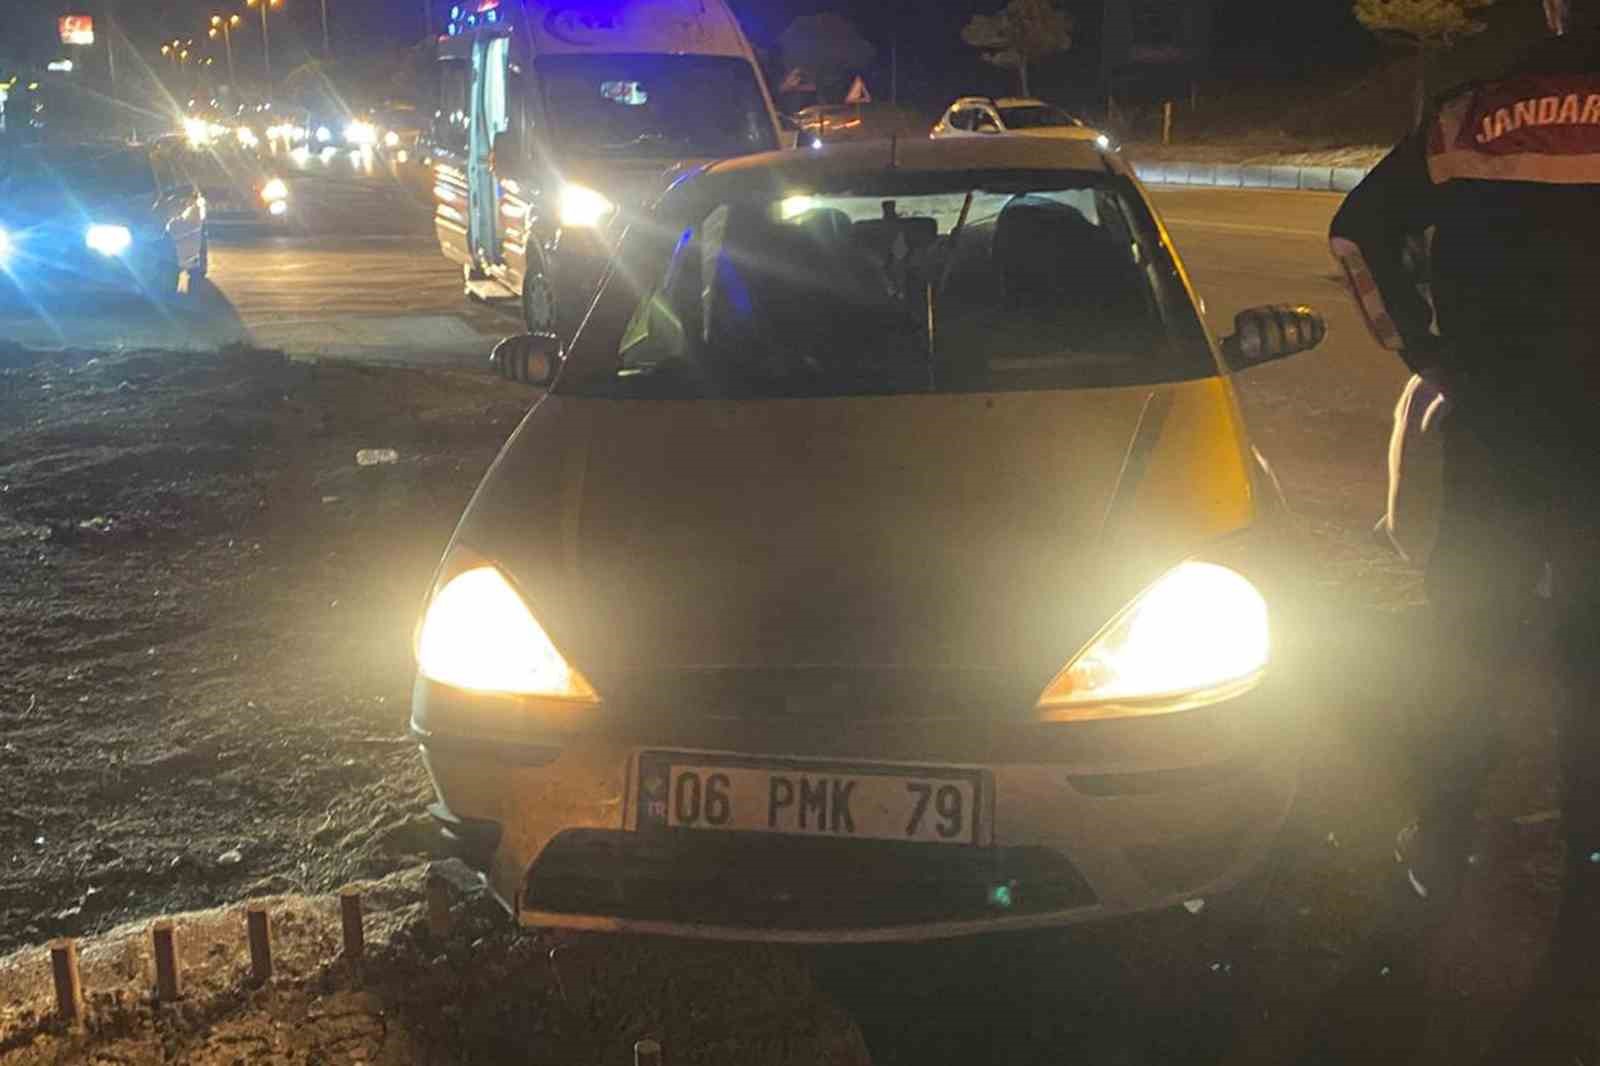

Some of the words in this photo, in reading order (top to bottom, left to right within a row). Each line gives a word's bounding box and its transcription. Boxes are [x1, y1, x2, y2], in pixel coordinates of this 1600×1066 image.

[675, 771, 731, 826] 06
[768, 776, 855, 833] PMK
[905, 782, 962, 839] 79
